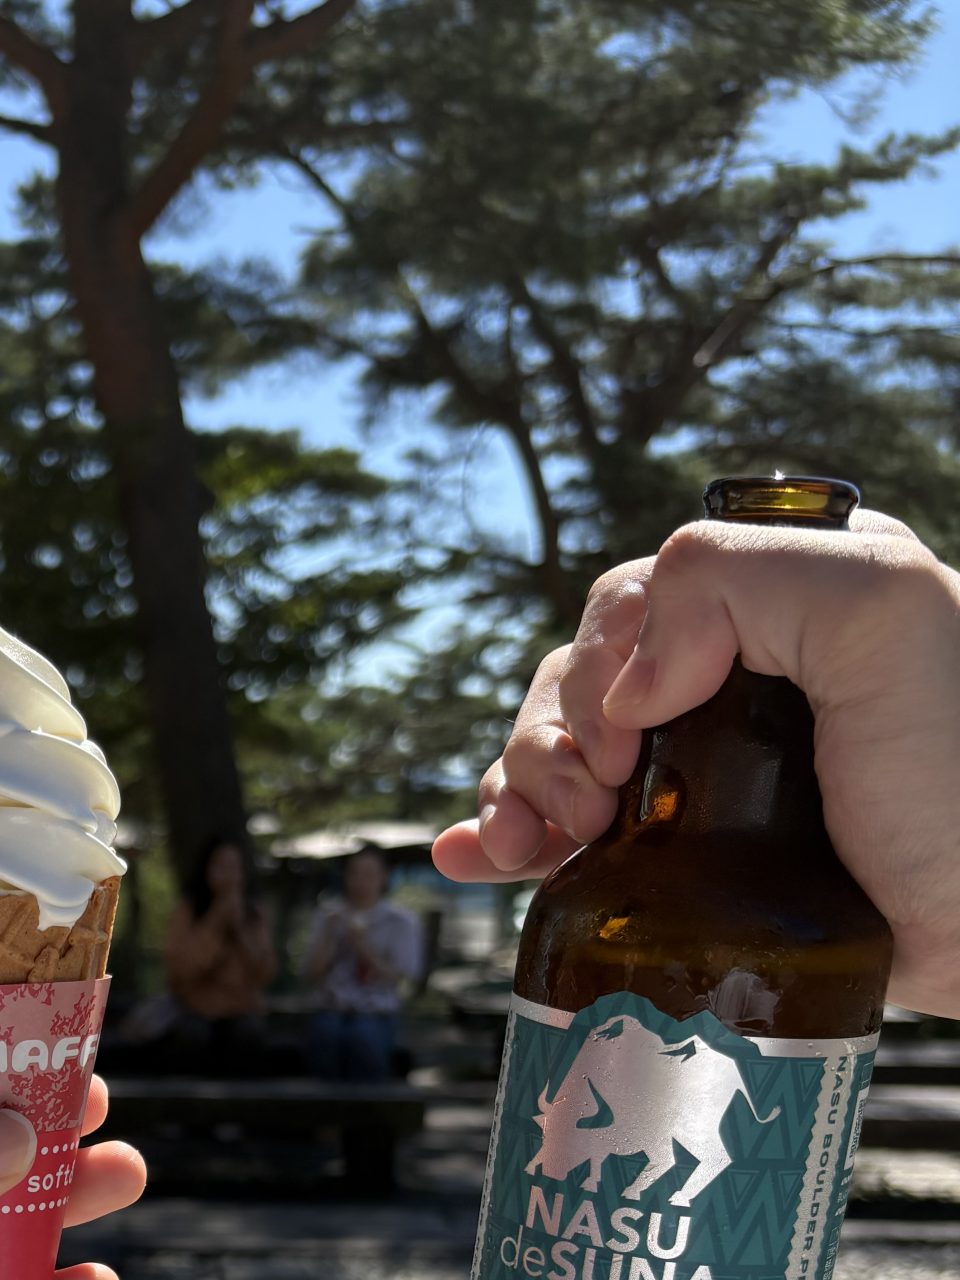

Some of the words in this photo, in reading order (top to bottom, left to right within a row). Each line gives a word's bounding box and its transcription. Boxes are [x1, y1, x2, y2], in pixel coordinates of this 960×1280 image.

[828, 1056, 848, 1125] NASU
[525, 1185, 693, 1260] NASU
[802, 1133, 833, 1252] BOULDER
